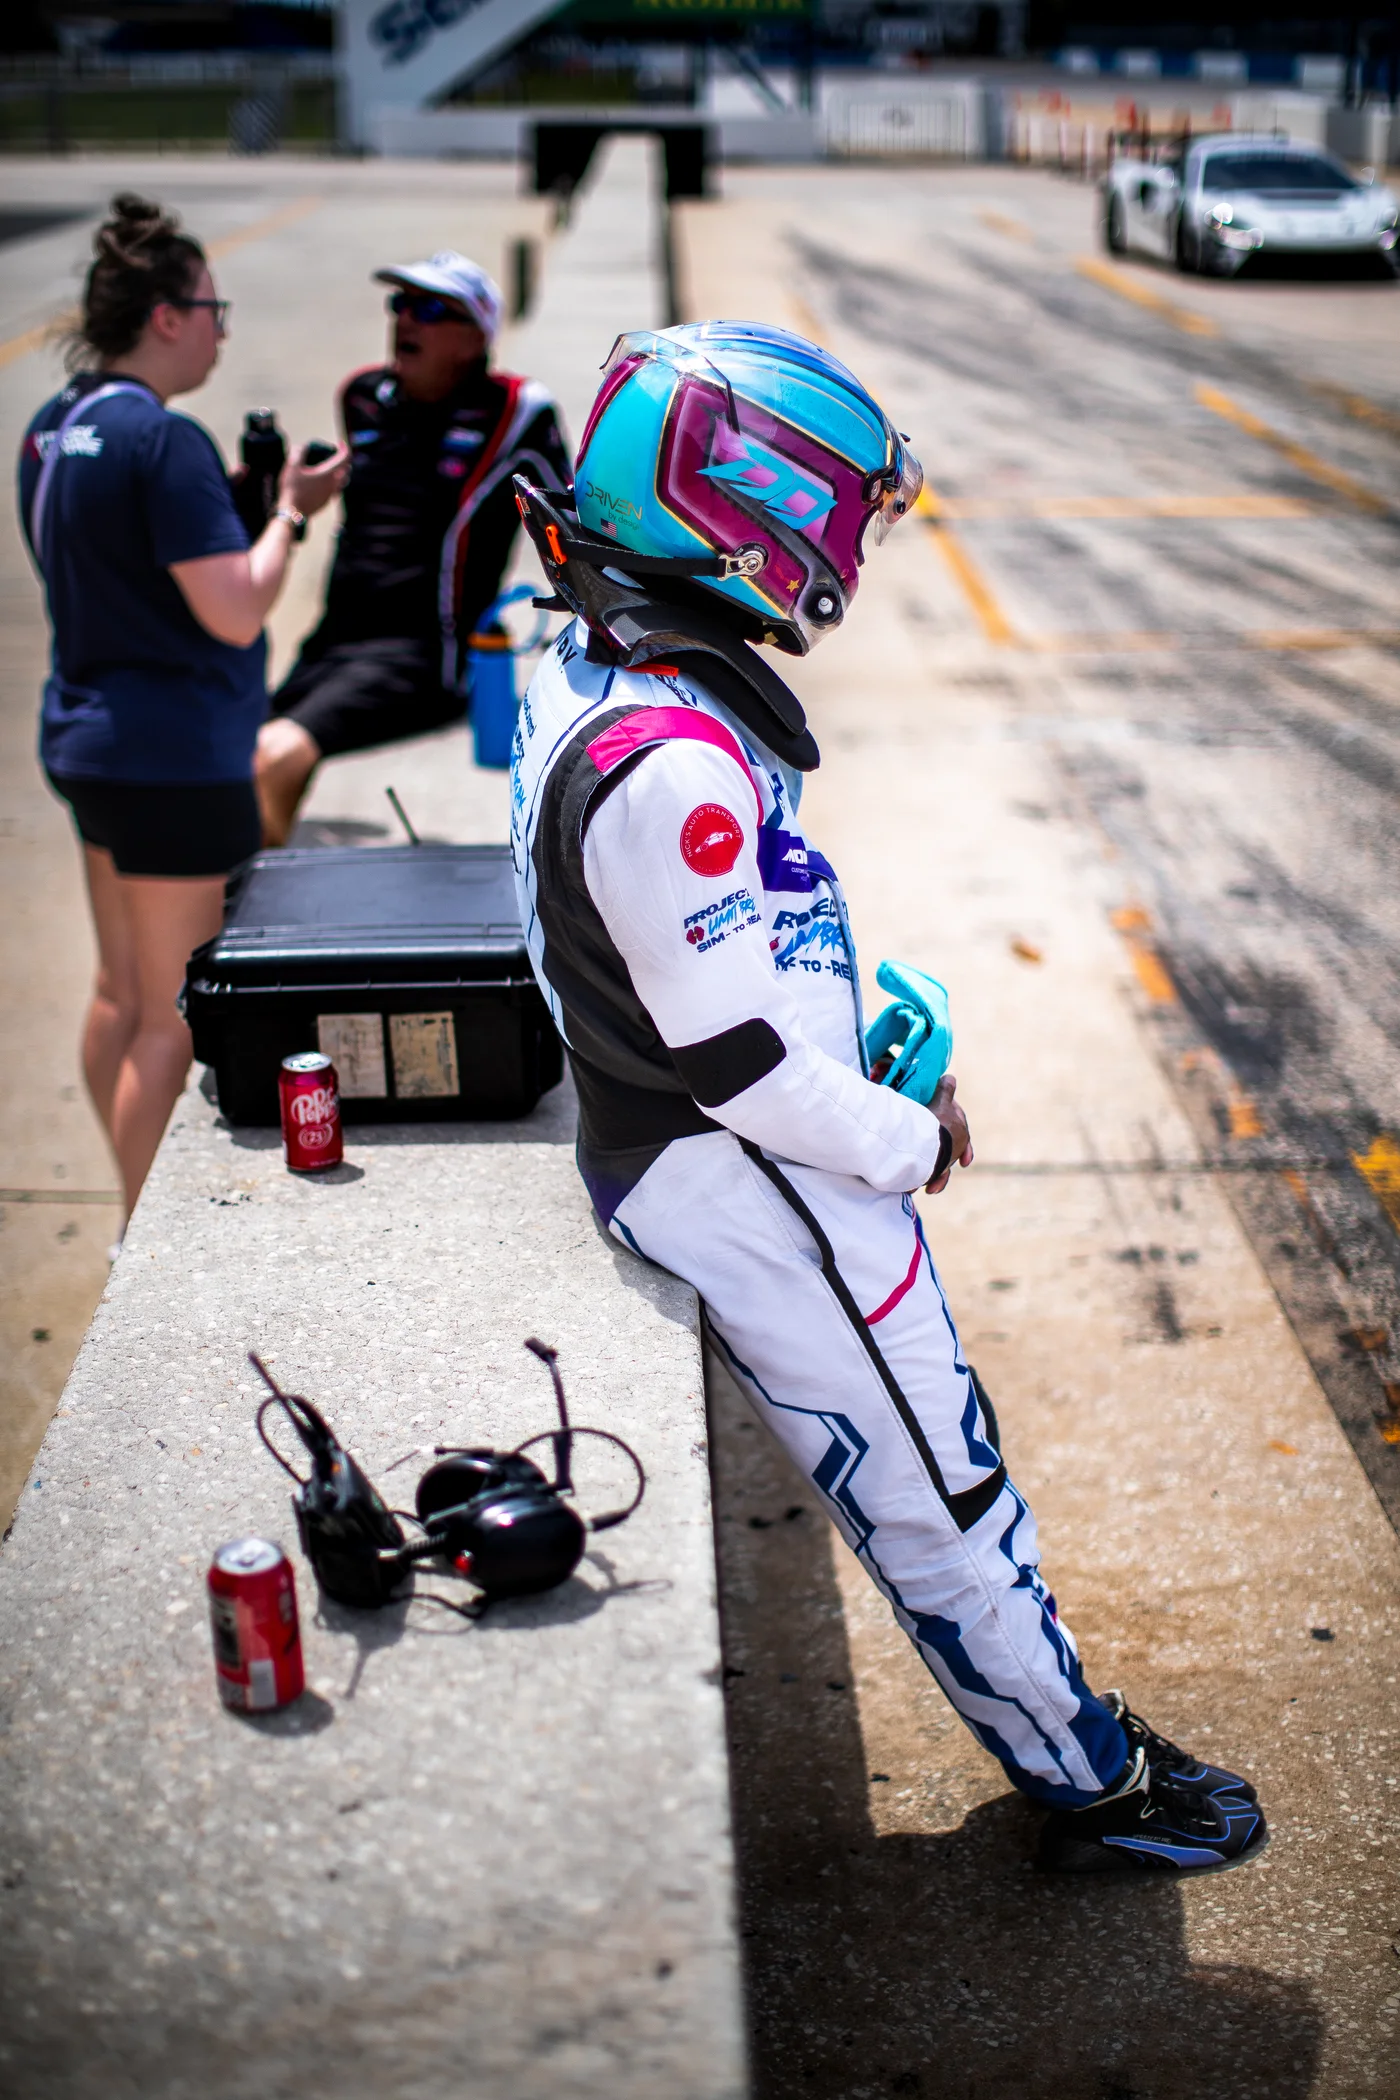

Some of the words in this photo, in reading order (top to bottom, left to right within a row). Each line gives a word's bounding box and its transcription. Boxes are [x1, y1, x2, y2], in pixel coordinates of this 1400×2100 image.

[585, 480, 643, 520] DRIVEN
[688, 810, 704, 831] AUTO
[706, 807, 741, 838] TRANSPORT
[684, 831, 694, 858] NICK'S
